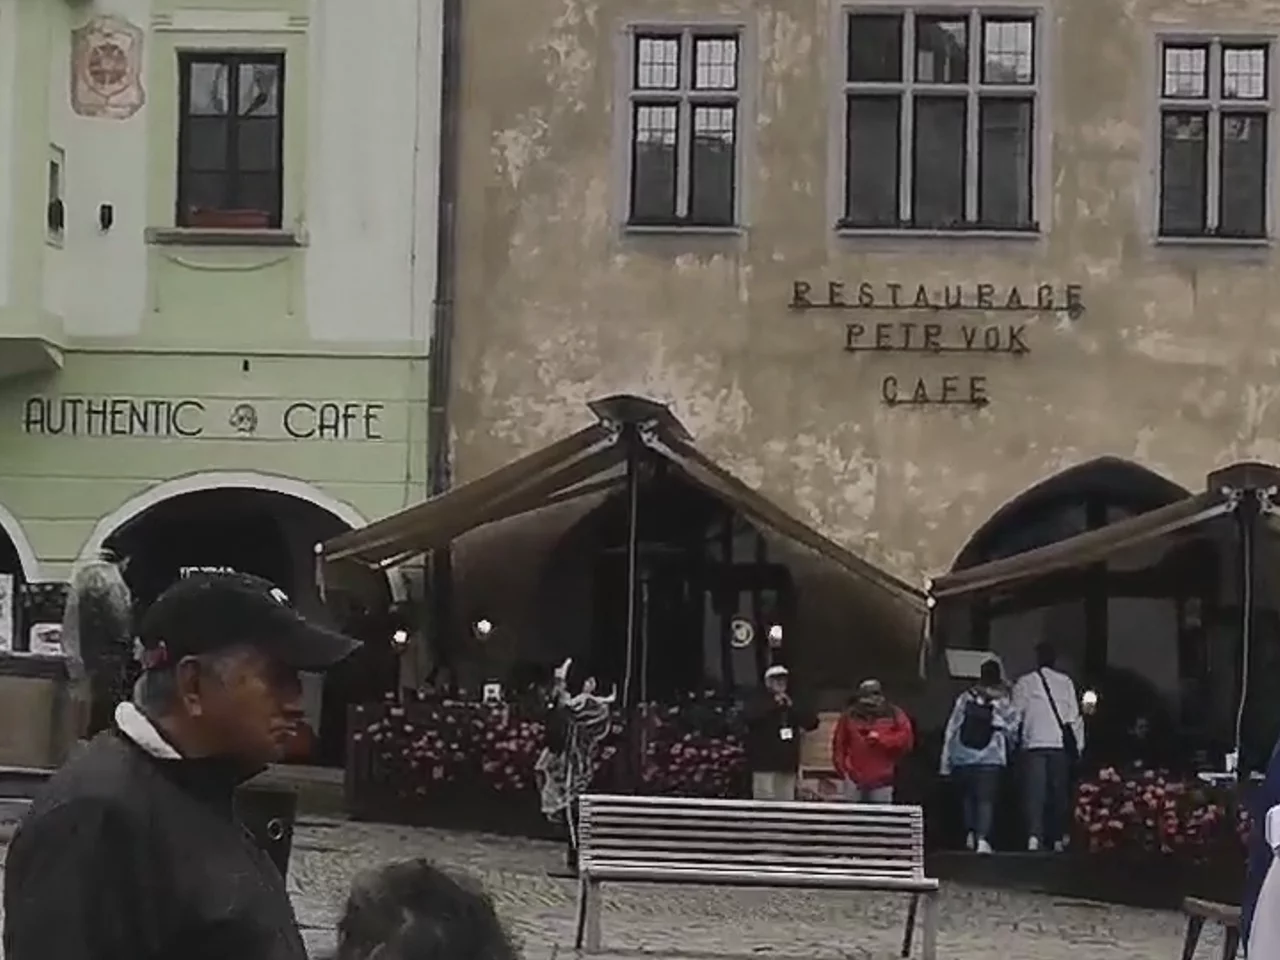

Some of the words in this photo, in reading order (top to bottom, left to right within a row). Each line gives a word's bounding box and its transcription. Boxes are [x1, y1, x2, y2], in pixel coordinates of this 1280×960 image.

[792, 280, 1084, 311] RESTAURACE
[846, 322, 942, 352] PETR
[961, 324, 1029, 352] VOK
[881, 374, 989, 406] CAFE
[24, 397, 206, 437] AUTHENTIC
[282, 401, 385, 440] CAFE
